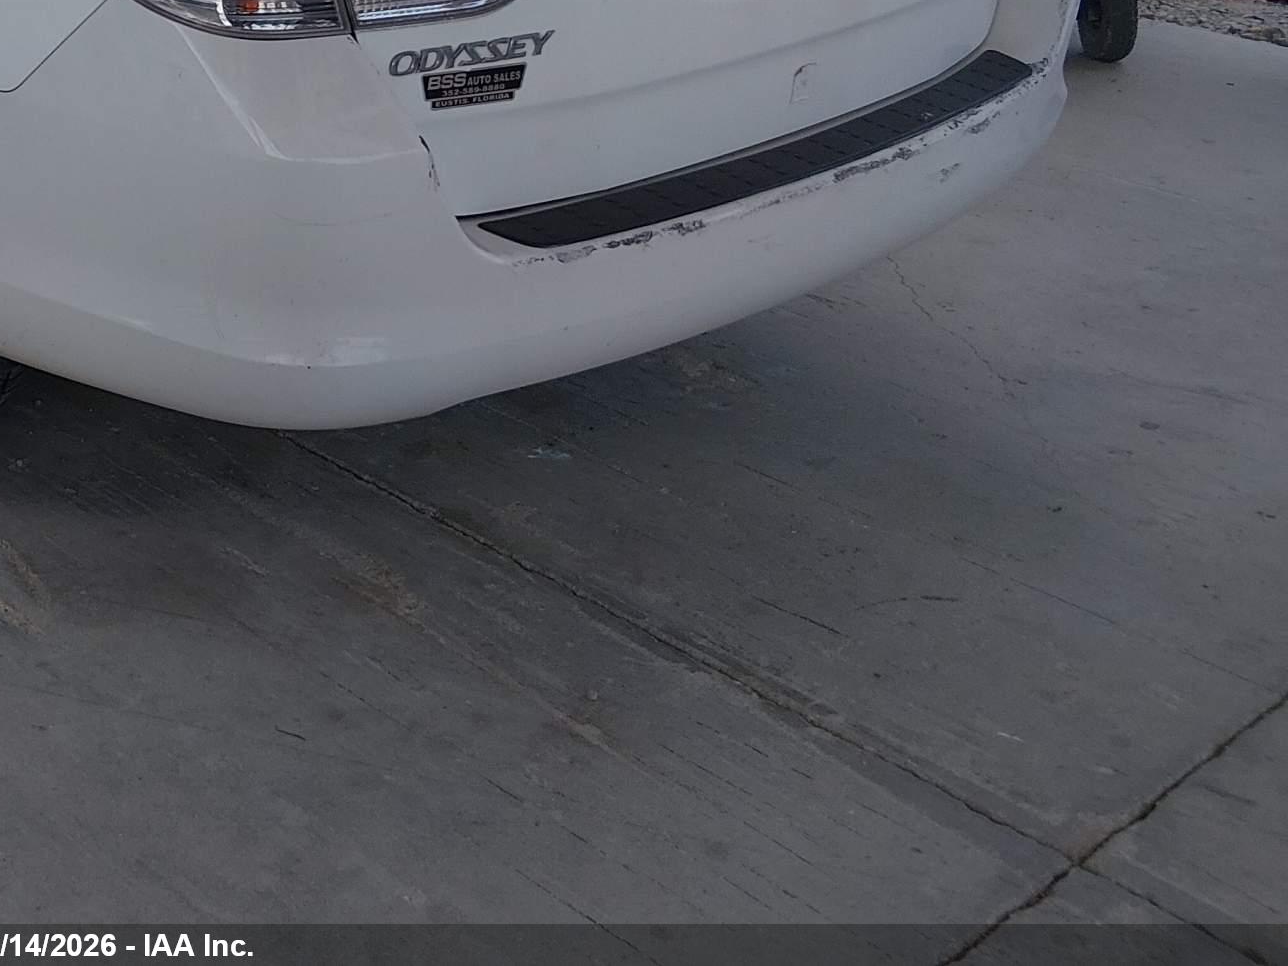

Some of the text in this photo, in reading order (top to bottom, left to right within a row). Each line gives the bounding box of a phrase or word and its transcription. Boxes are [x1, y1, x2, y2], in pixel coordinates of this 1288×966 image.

[389, 30, 555, 76] ODYSSEY
[427, 70, 521, 91] BSS AUTO SALES
[472, 93, 510, 103] FLORIDA
